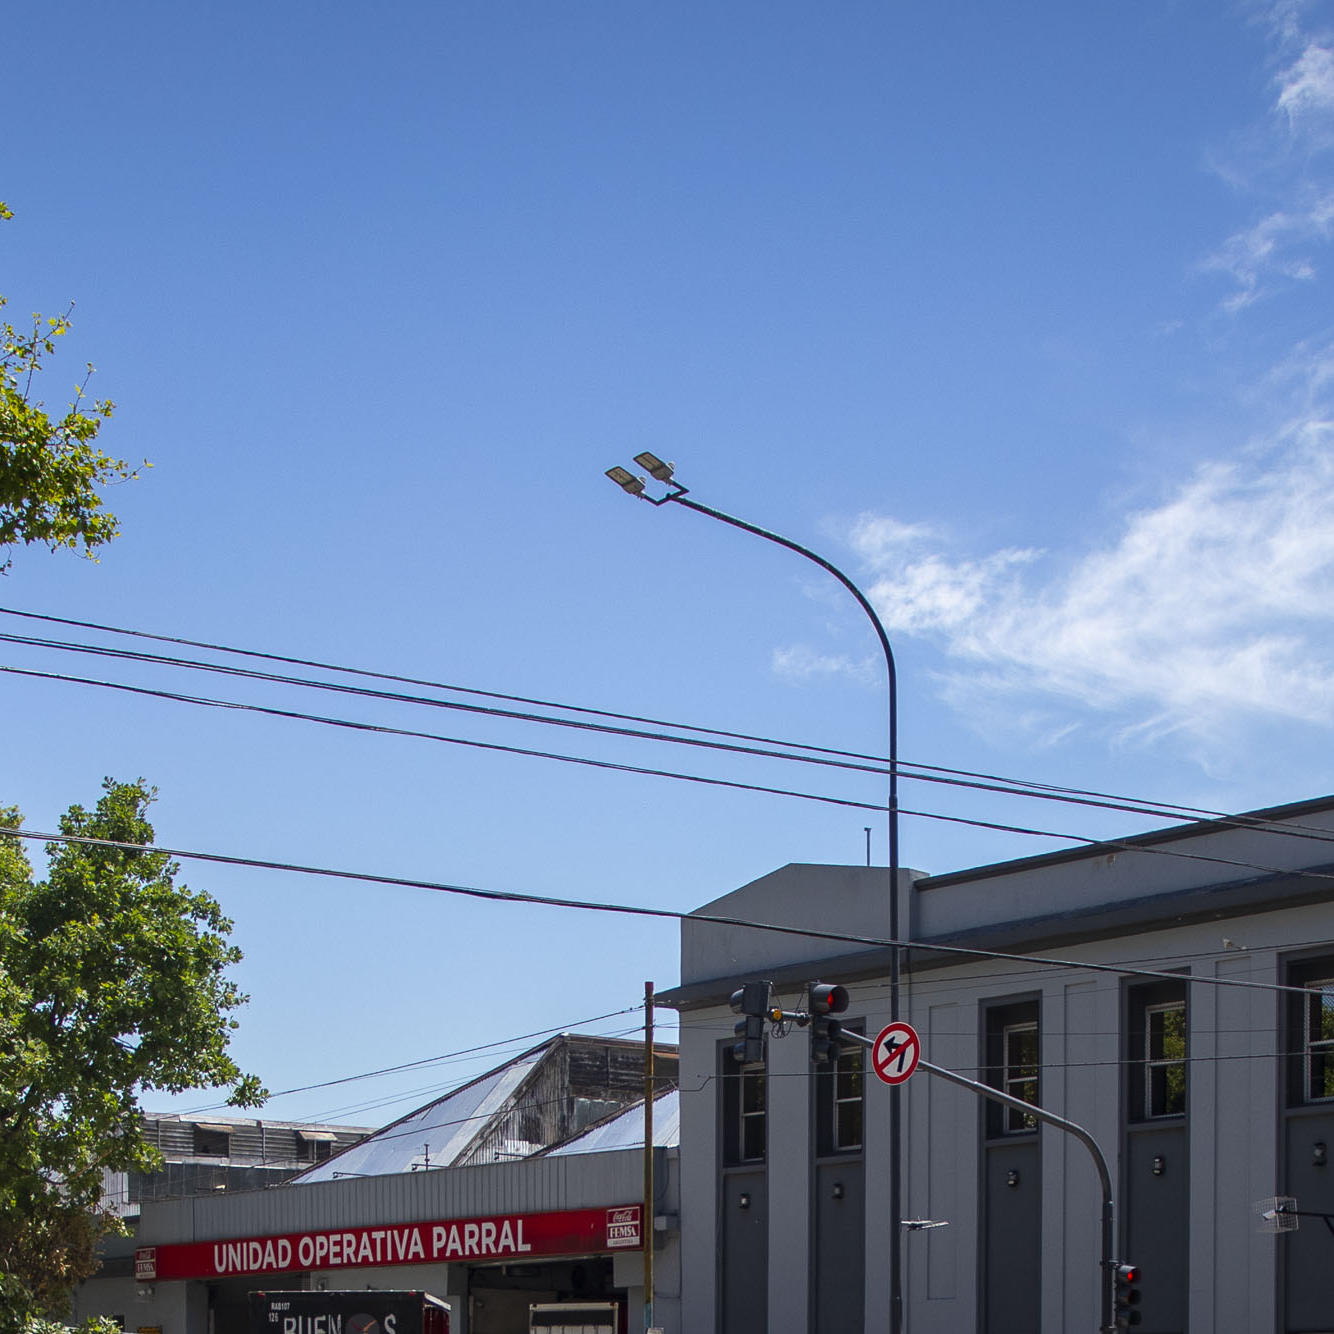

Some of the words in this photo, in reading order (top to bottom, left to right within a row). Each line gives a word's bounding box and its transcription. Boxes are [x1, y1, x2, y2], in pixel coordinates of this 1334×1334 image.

[214, 1239, 292, 1273] UNIDAD
[298, 1227, 425, 1267] OPERATIVA
[432, 1219, 531, 1258] PARRAL
